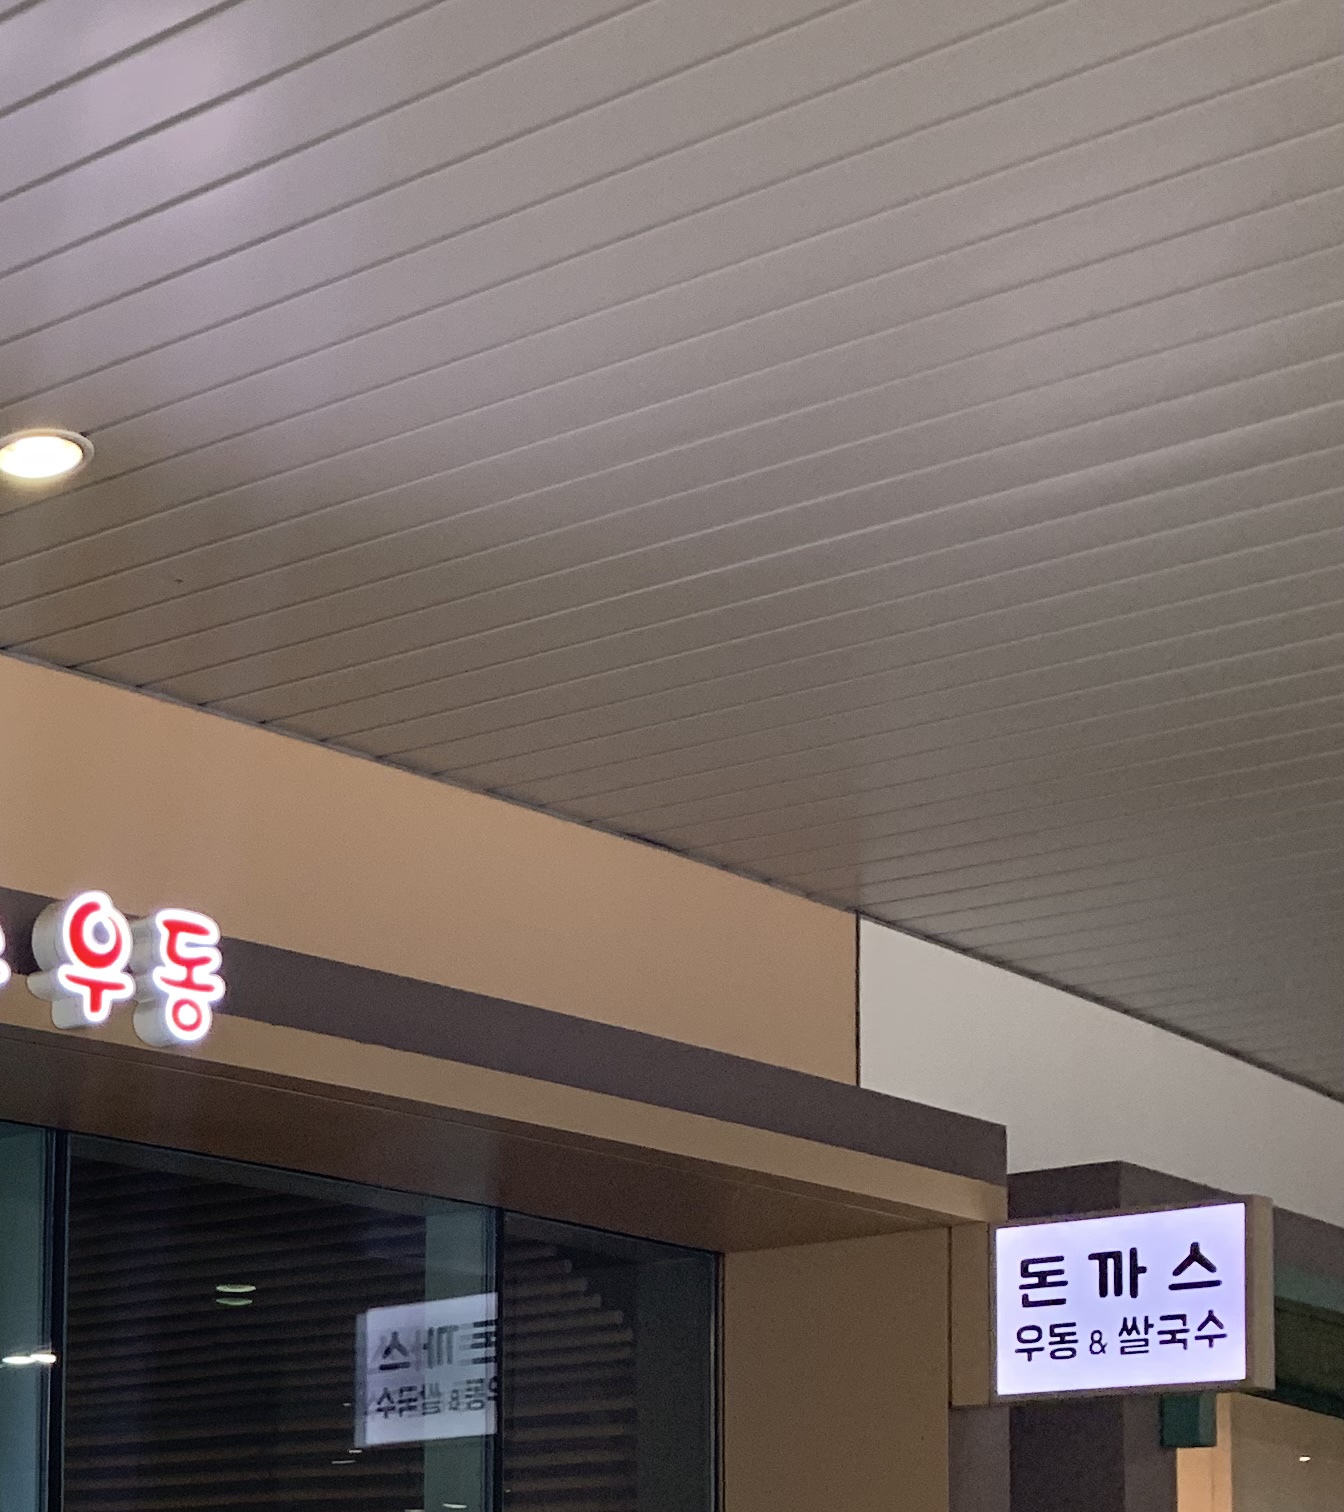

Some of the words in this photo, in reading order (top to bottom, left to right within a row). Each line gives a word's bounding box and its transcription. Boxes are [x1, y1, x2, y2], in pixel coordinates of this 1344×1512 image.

[61, 890, 227, 1043] 우동
[1018, 1241, 1223, 1308] 돈까스
[1015, 1321, 1079, 1362] 우동
[1118, 1309, 1228, 1356] 쌀국수
